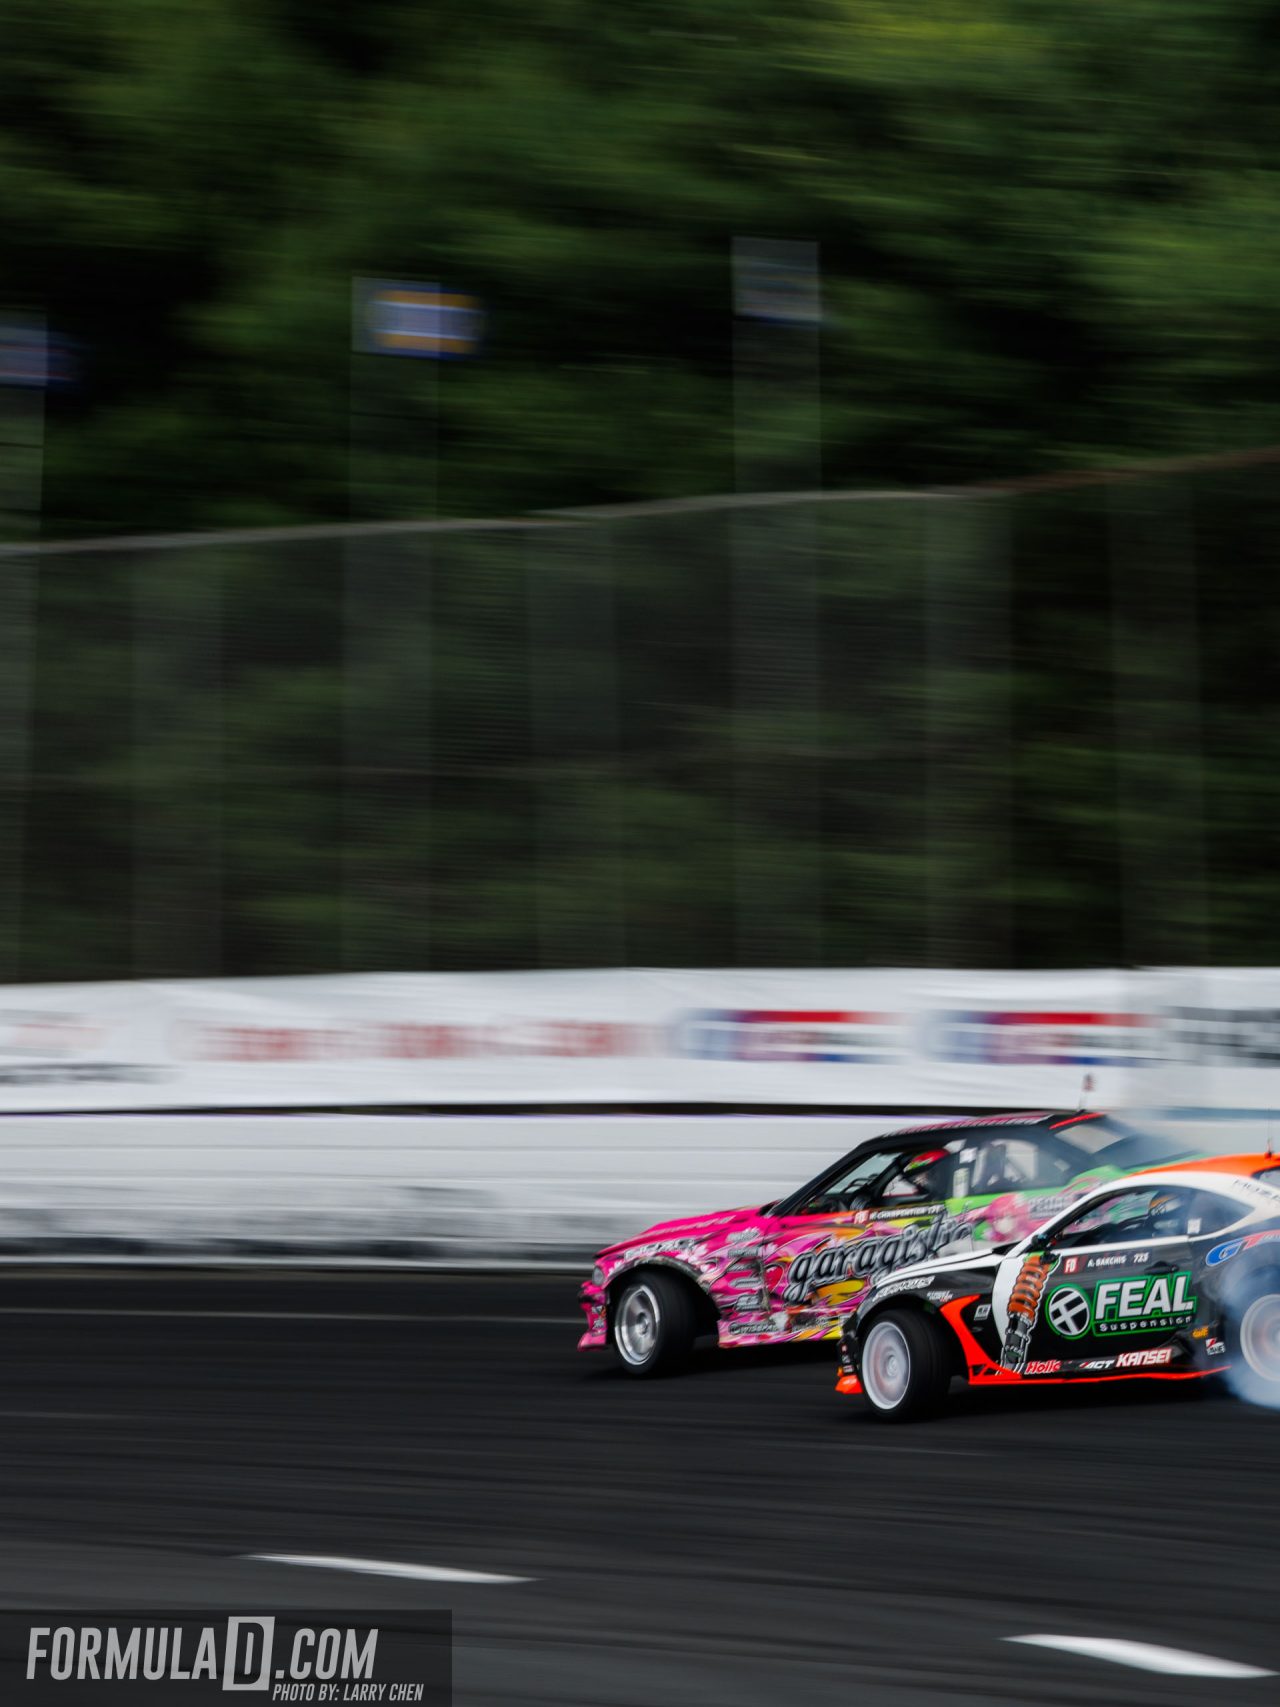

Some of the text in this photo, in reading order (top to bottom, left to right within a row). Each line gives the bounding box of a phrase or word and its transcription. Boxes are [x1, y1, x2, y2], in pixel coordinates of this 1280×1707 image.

[1095, 1276, 1193, 1319] FEAL
[1099, 1316, 1193, 1332] Suspension
[1080, 1359, 1115, 1370] ACT
[1116, 1348, 1172, 1367] KANSEI
